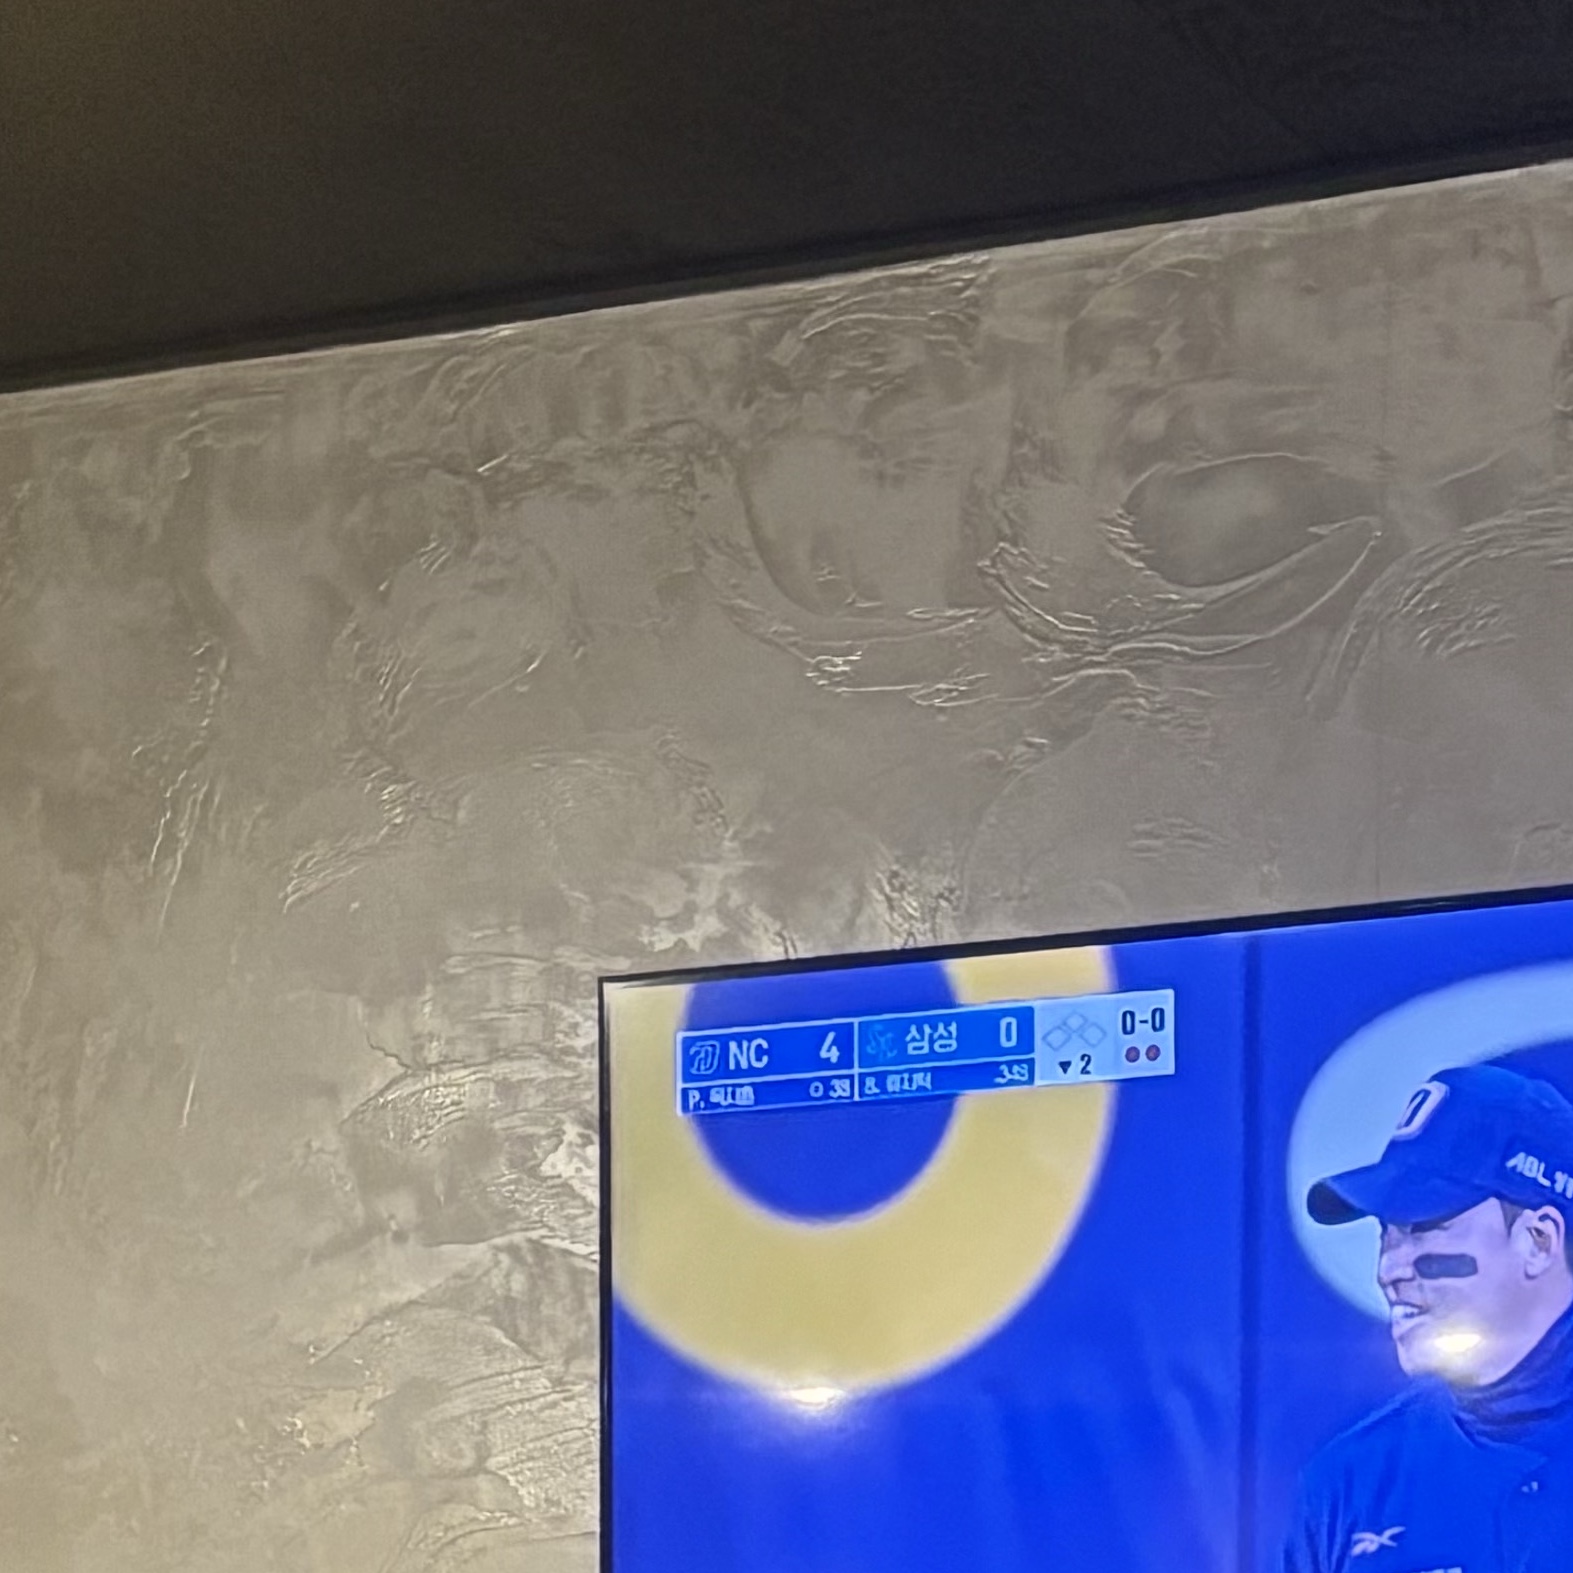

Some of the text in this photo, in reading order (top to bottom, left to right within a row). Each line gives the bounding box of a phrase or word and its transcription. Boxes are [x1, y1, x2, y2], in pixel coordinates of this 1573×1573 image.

[1121, 1007, 1165, 1036] 0-0
[728, 1016, 1018, 1071] NC 4 삼성 0
[1079, 1053, 1092, 1075] 2
